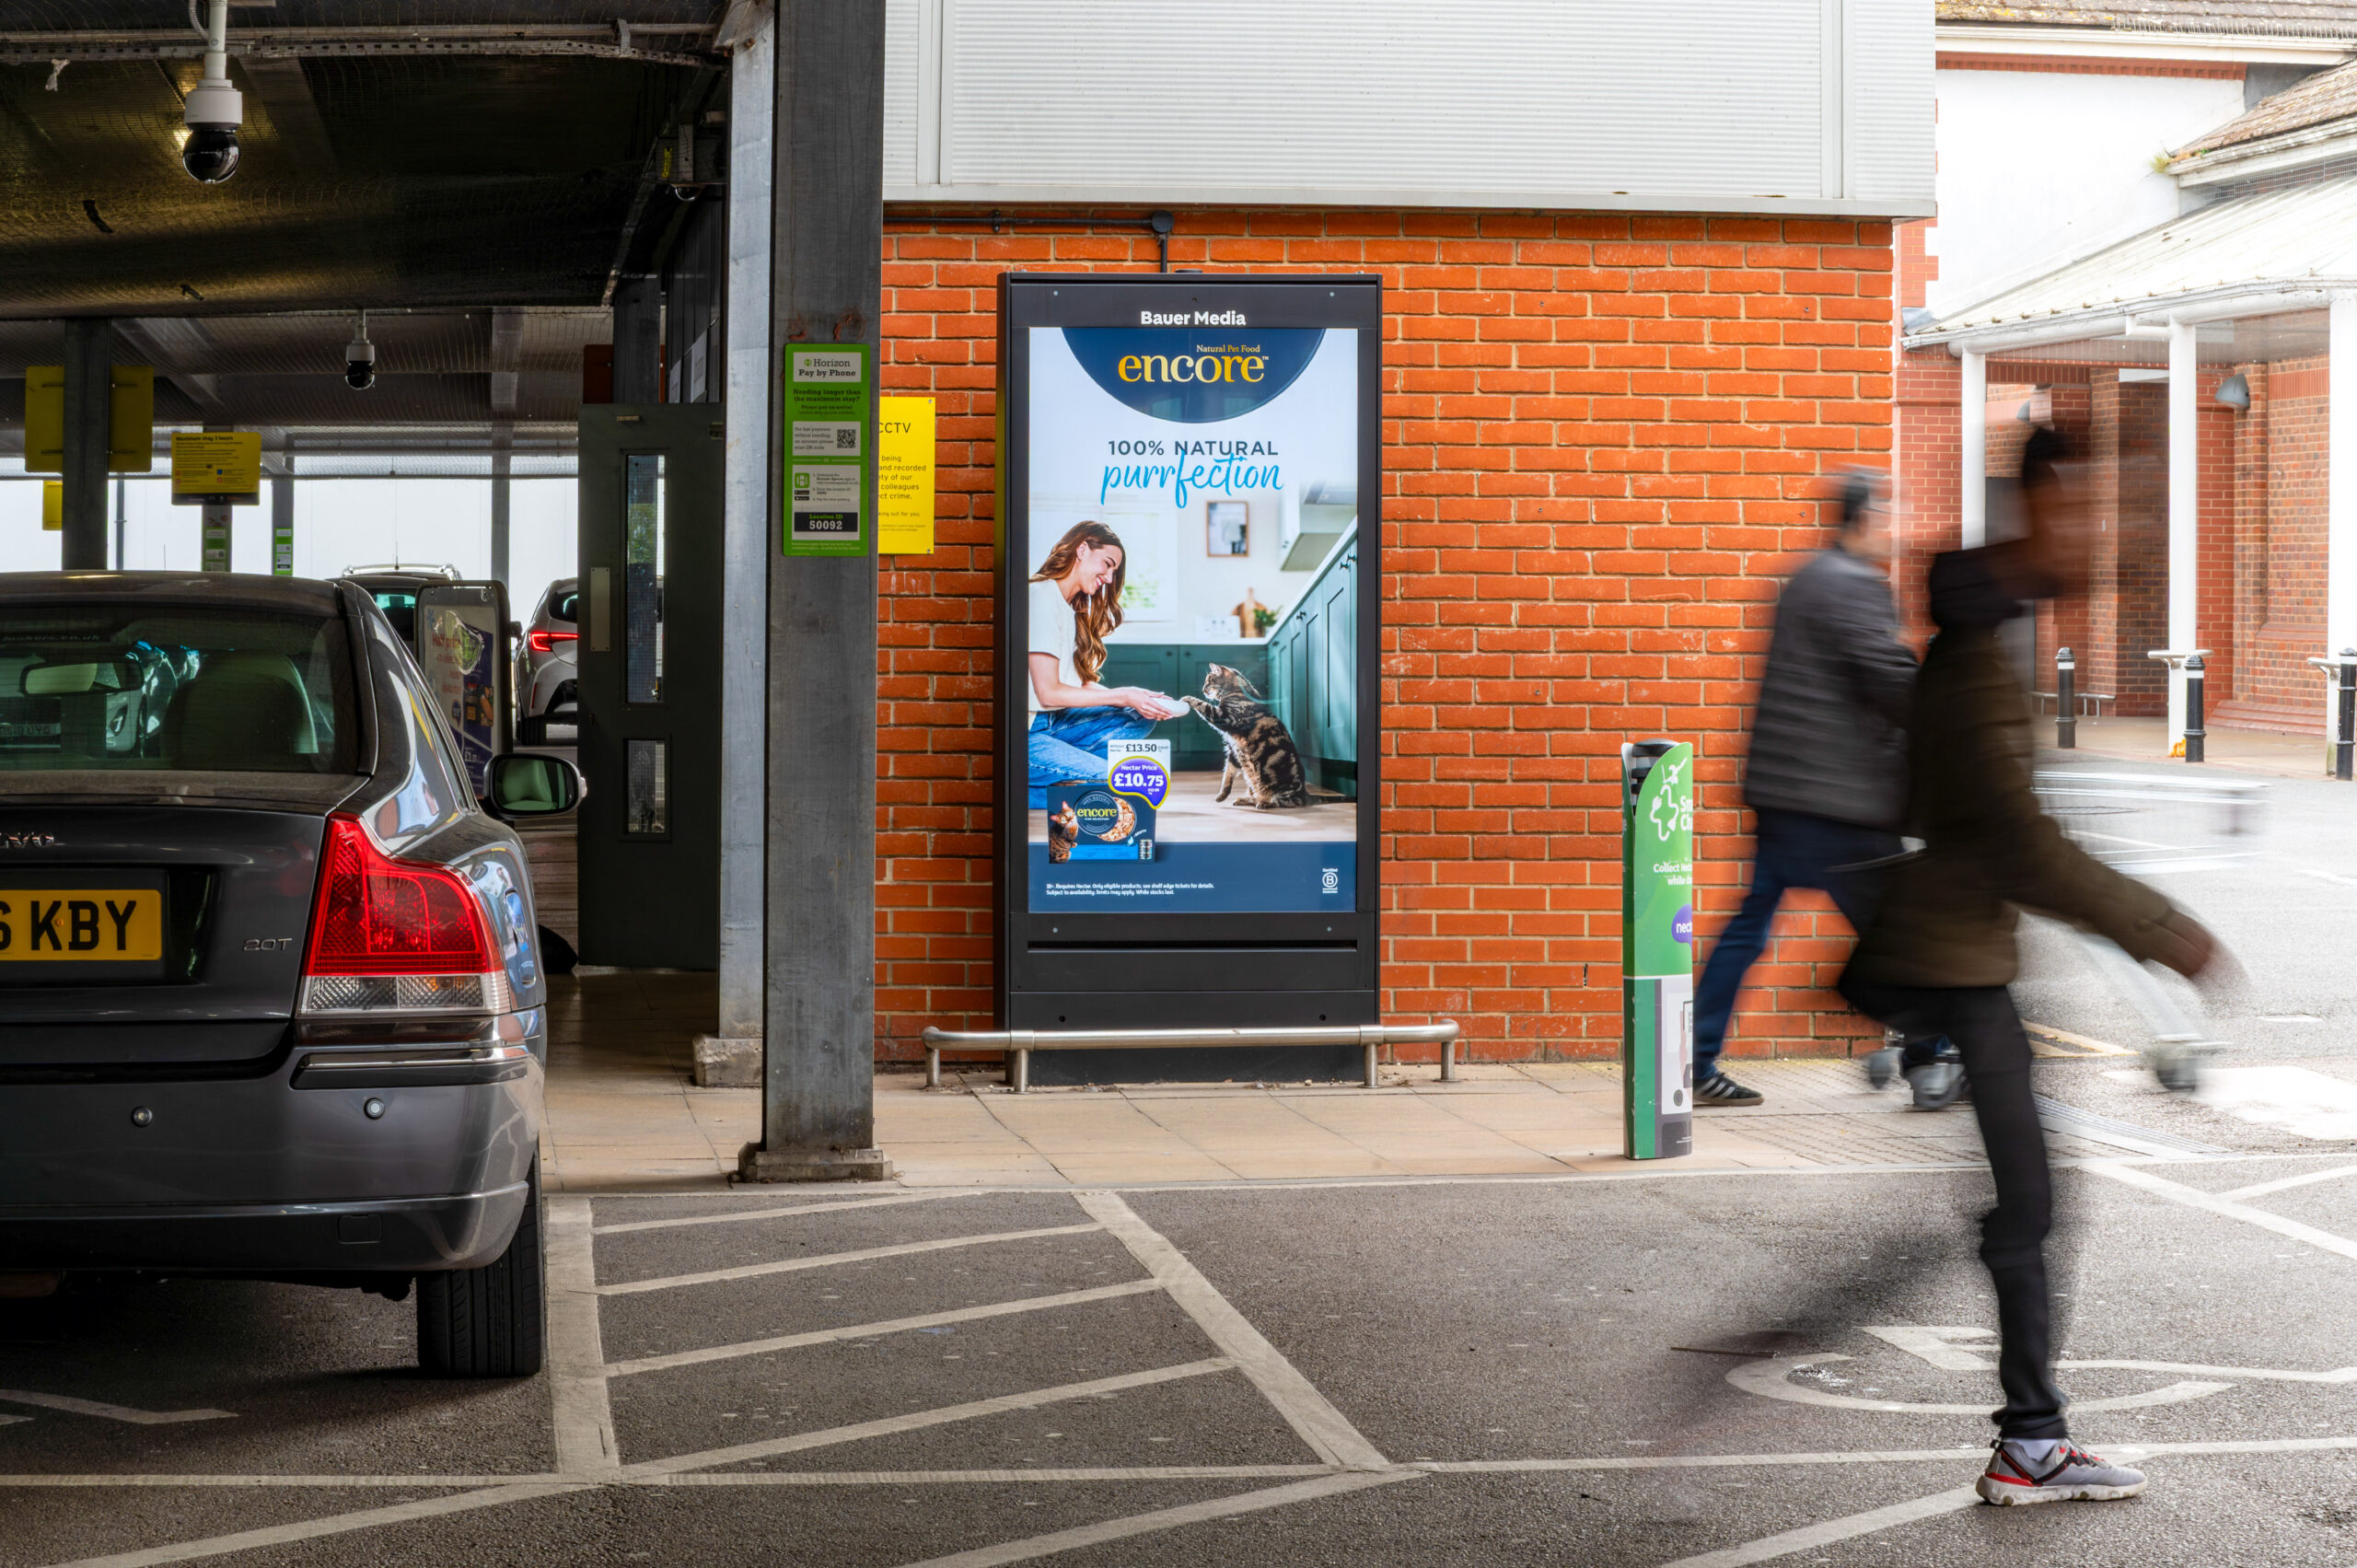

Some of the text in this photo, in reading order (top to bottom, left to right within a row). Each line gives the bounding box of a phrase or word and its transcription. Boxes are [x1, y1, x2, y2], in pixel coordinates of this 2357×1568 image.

[1140, 310, 1247, 326] Bauer Media
[1196, 344, 1260, 353] Natural Pet Food
[813, 358, 851, 367] Horizon
[798, 369, 814, 377] Pay
[817, 369, 827, 377] by
[1109, 440, 1279, 456] 100% NATURAL
[881, 455, 902, 463] being
[1100, 449, 1284, 509] purrfection
[880, 483, 920, 492] colleagues
[809, 520, 842, 529] 50092
[1125, 744, 1157, 752] £13.50
[1114, 772, 1164, 787] £10.75
[1076, 808, 1117, 818] encore
[1653, 862, 1679, 873] Collect
[1667, 875, 1686, 885] while
[30, 900, 137, 951] KBY
